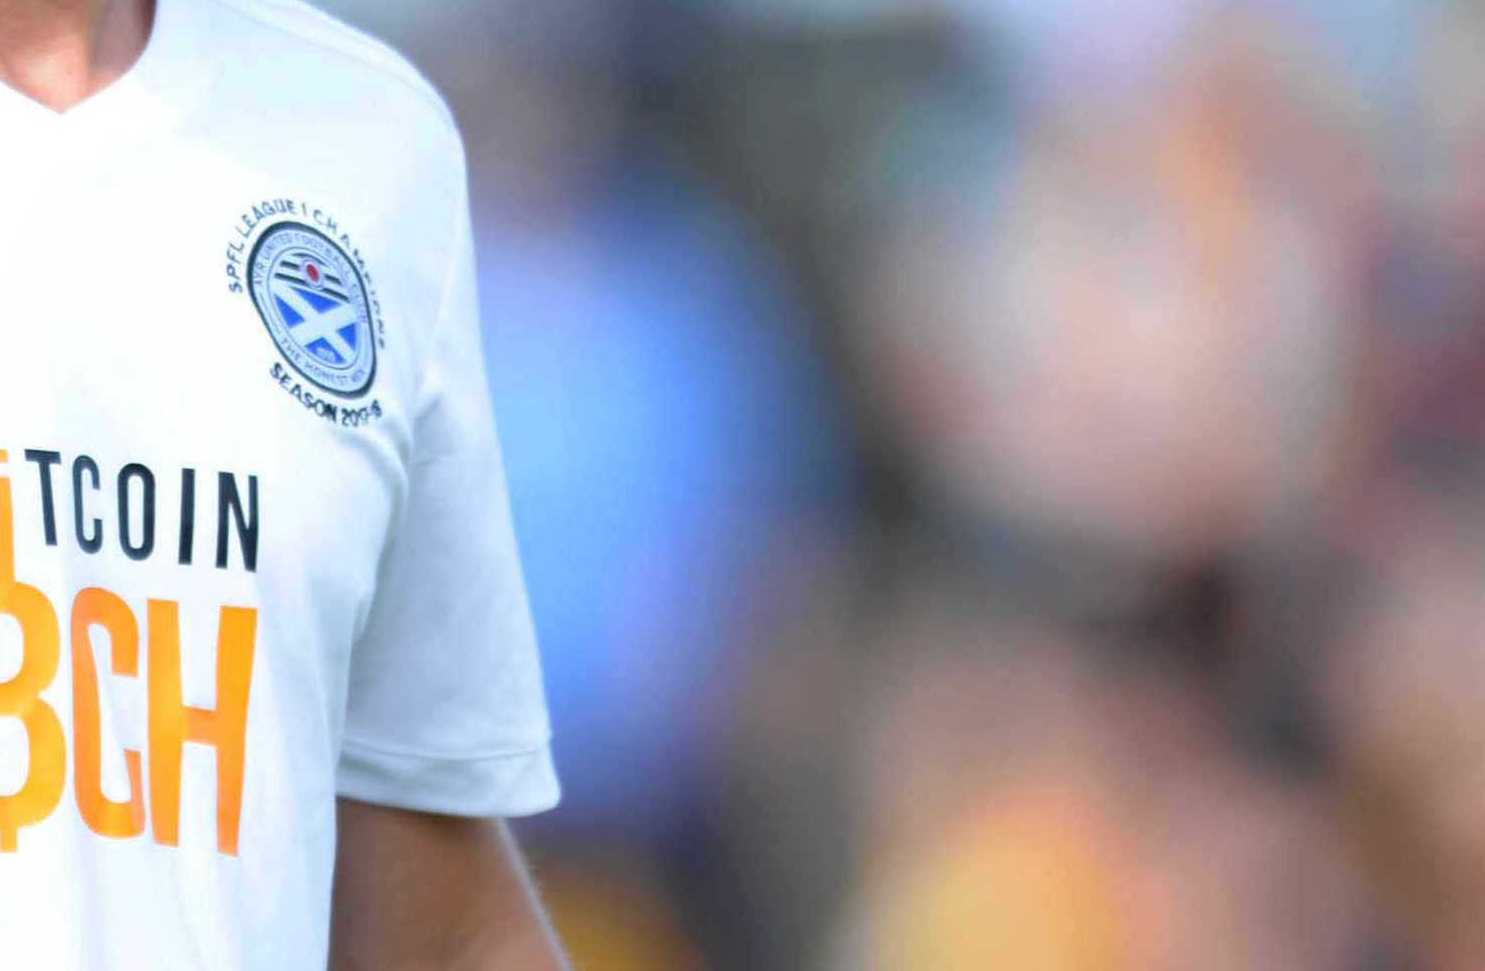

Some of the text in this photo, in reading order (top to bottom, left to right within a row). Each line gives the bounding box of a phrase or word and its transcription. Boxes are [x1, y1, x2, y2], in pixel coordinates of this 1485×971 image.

[234, 197, 296, 240] LEAGUE
[226, 241, 245, 293] SPFL
[269, 361, 338, 423] SEASON
